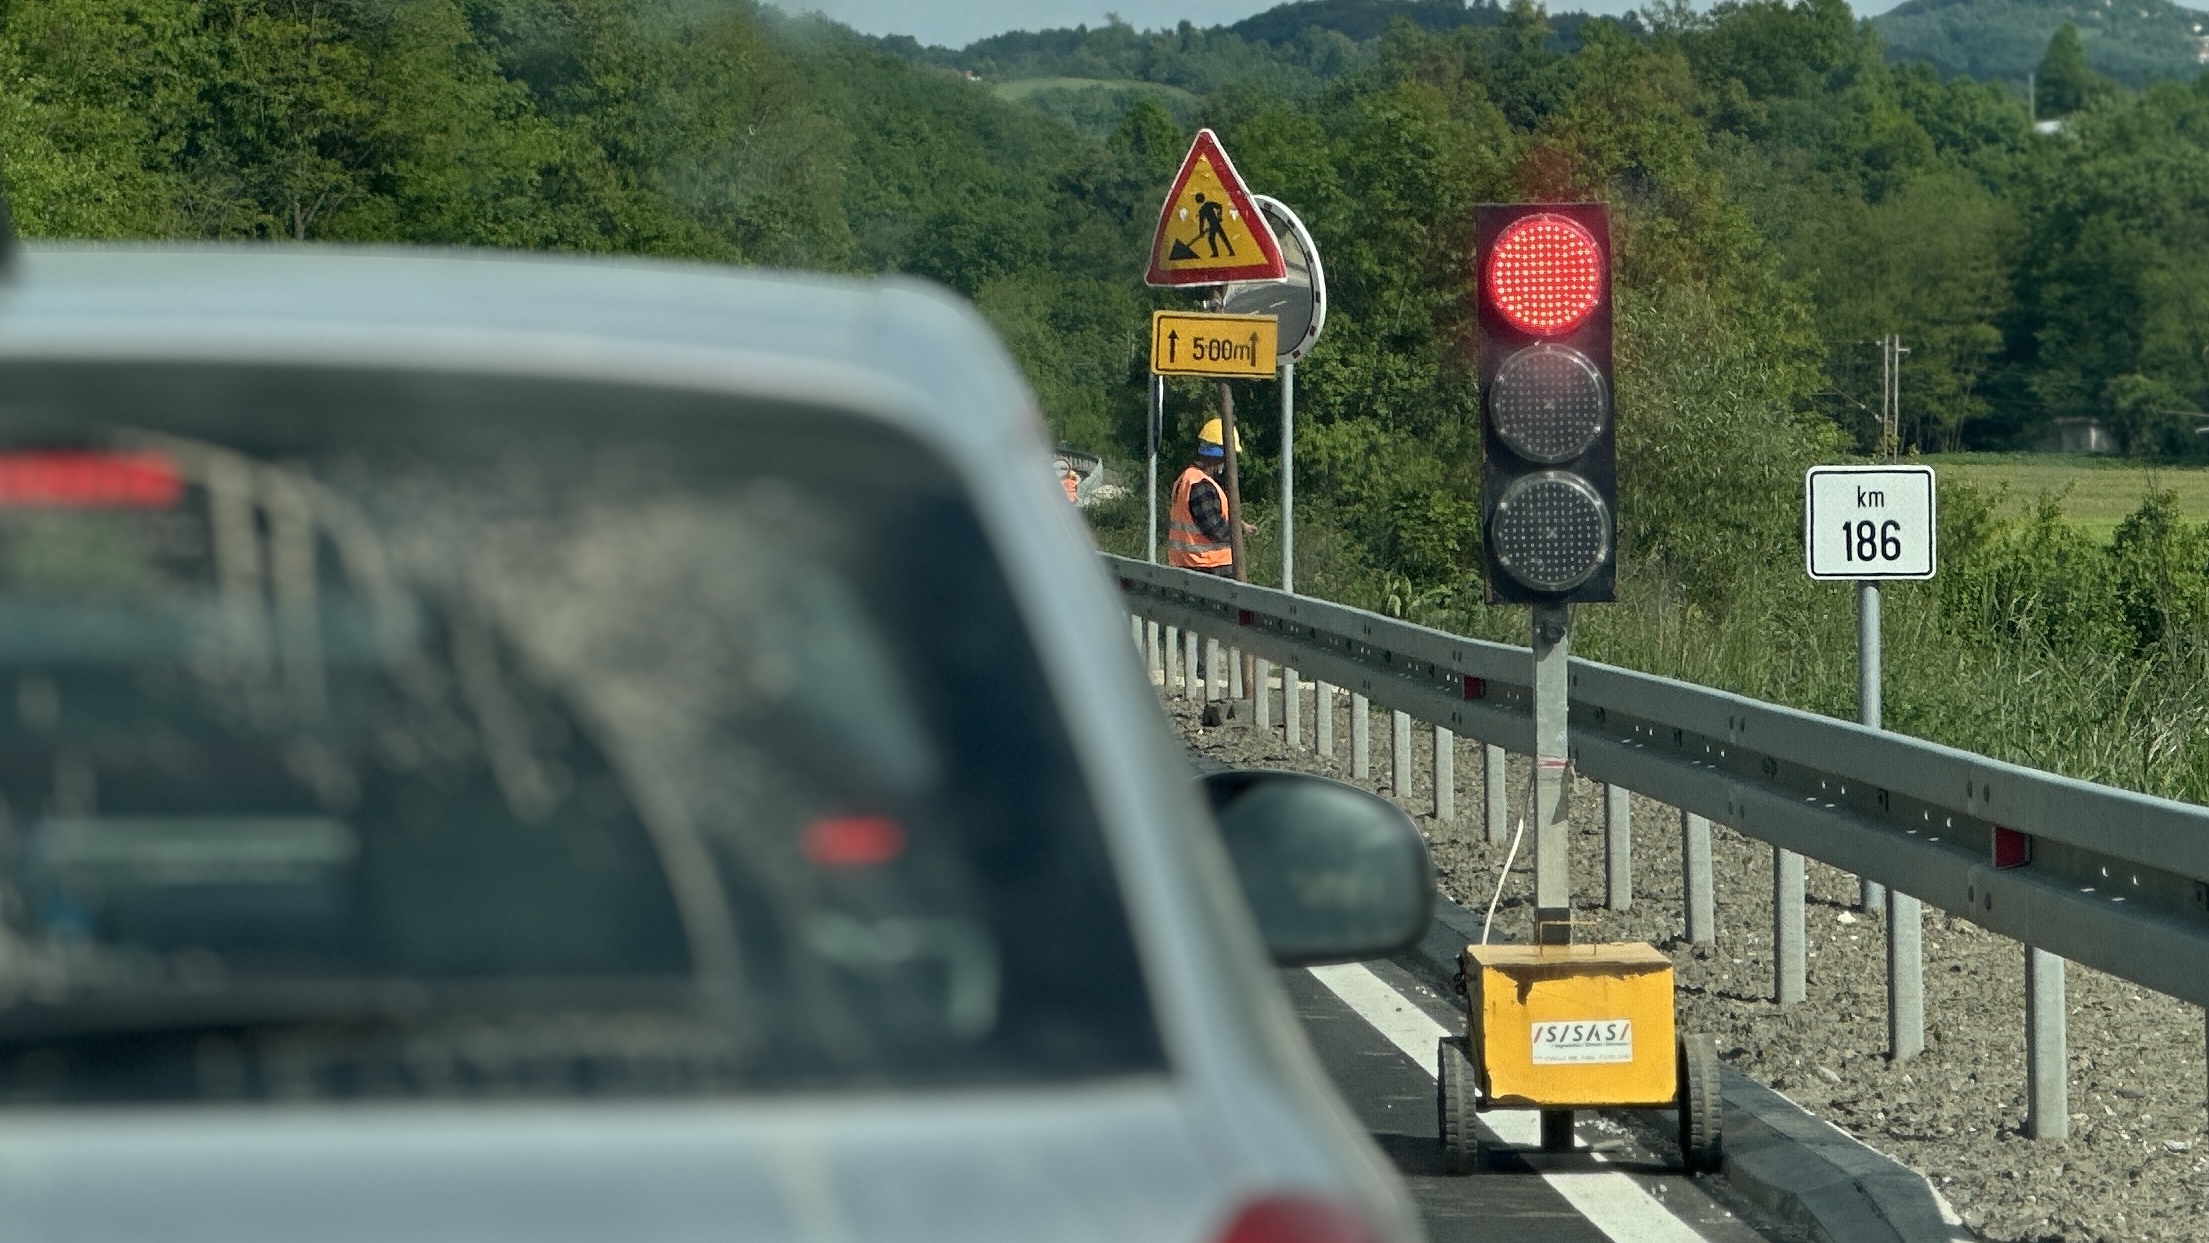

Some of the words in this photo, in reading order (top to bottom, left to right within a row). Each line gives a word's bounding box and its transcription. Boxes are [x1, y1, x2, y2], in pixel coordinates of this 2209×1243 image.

[1192, 337, 1251, 362] 500m
[1857, 485, 1885, 508] km
[1842, 519, 1901, 562] 186
